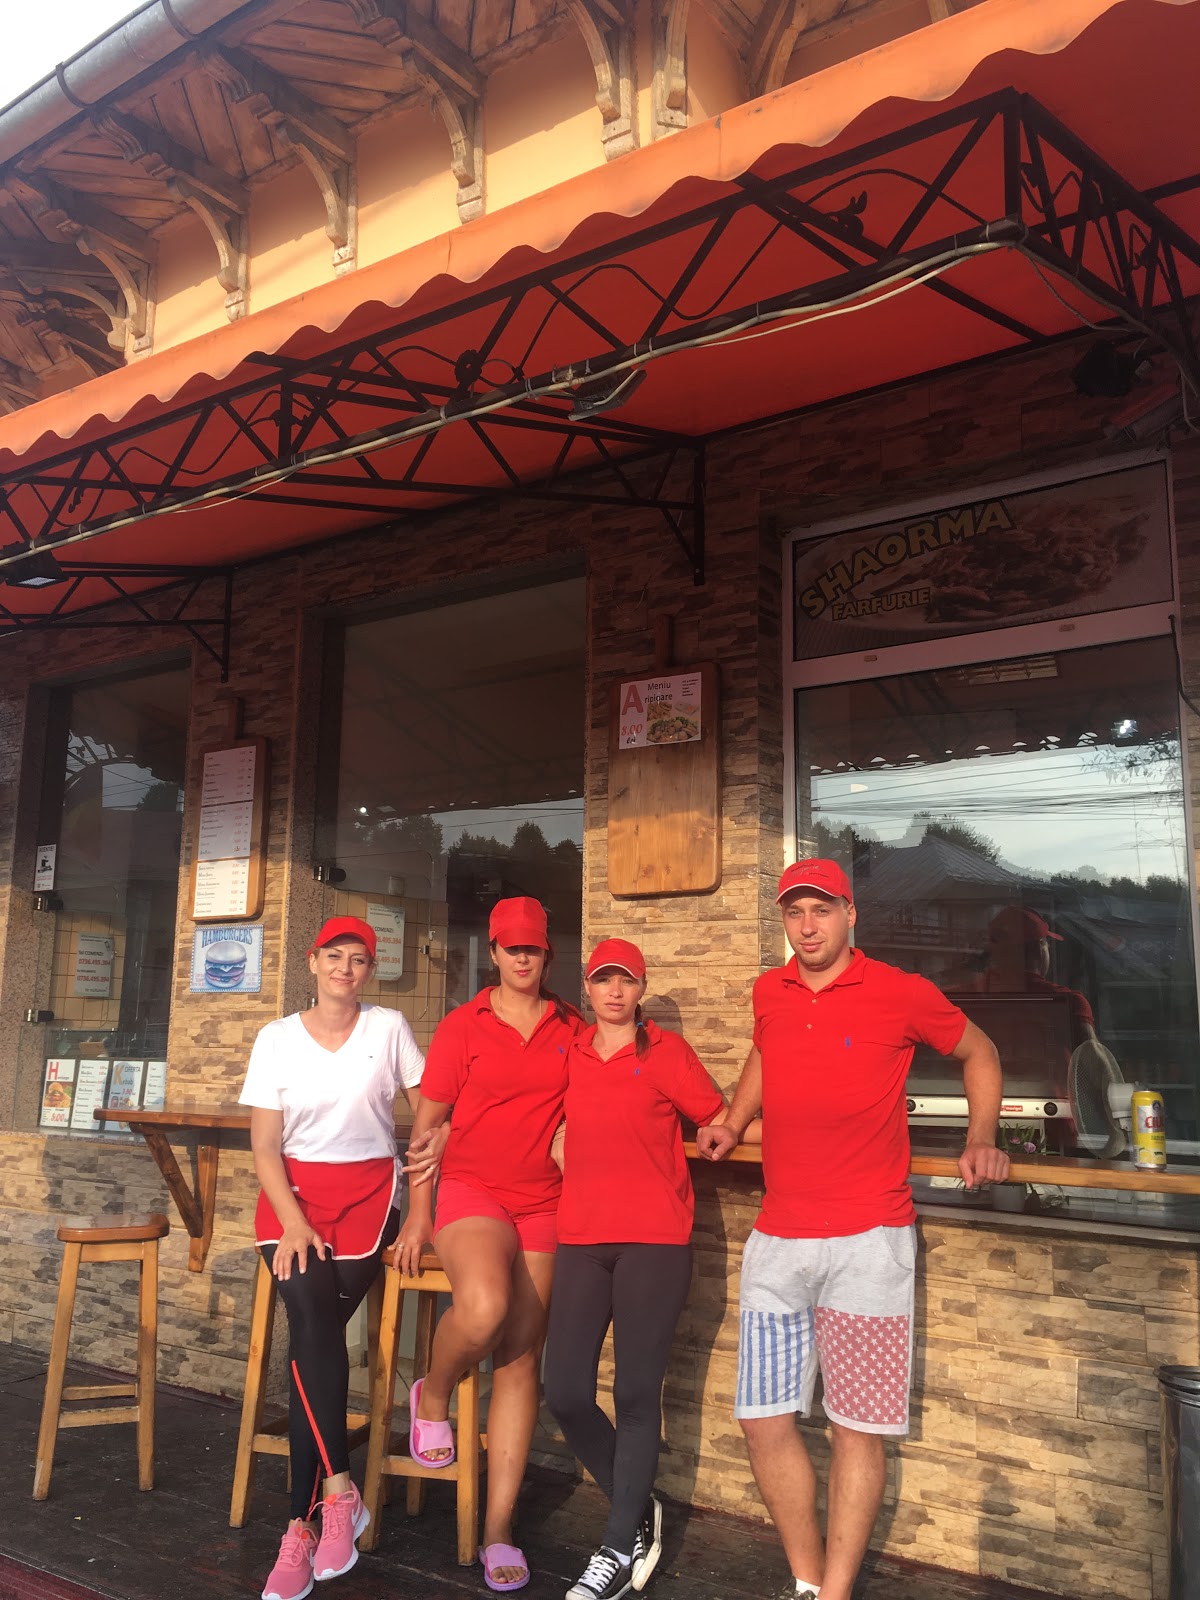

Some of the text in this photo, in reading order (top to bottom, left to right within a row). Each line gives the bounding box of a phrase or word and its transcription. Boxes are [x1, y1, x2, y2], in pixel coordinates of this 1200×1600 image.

[799, 501, 1015, 618] SHAORMA
[832, 587, 931, 621] FARFURIE
[647, 682, 671, 691] Meniu
[621, 684, 643, 716] A
[644, 693, 673, 704] ripioare
[621, 723, 642, 737] 8.00
[201, 929, 252, 948] HAMBURGERS
[47, 1061, 60, 1081] H
[113, 1065, 124, 1086] K
